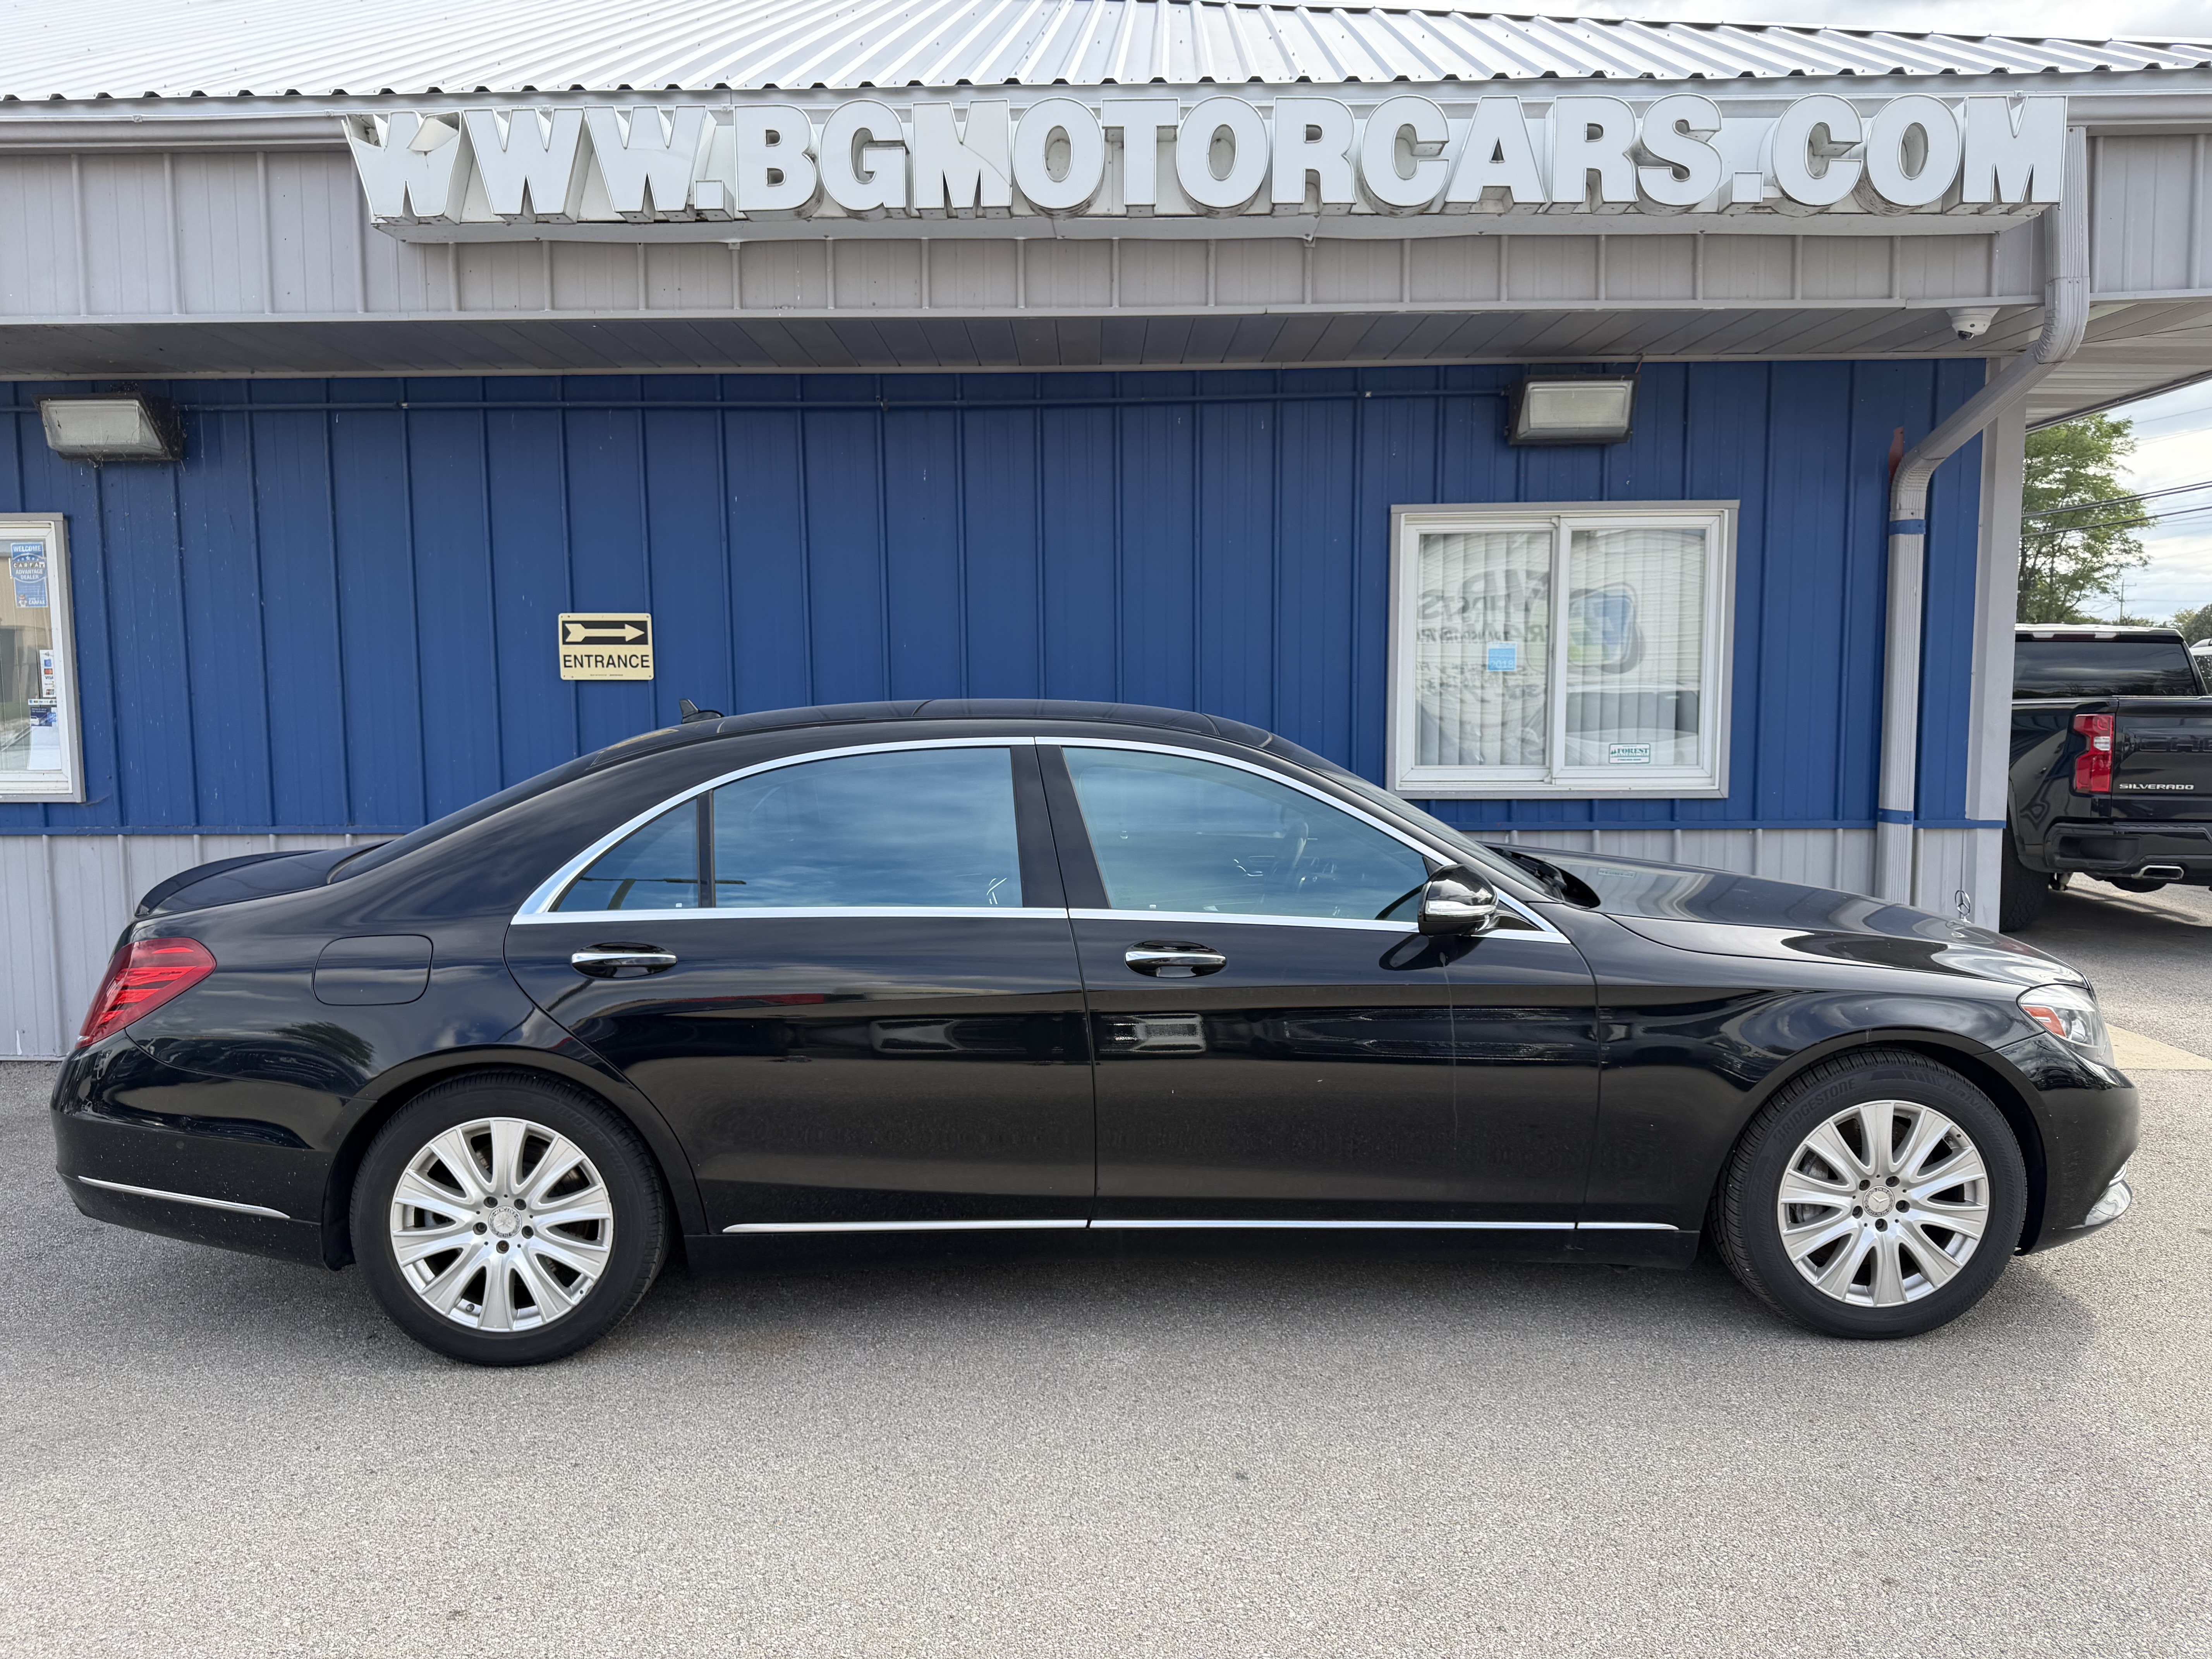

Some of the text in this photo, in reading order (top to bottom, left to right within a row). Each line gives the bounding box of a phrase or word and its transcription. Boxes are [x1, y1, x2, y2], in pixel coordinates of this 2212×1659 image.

[342, 92, 2068, 219] WWW.BGMOTORCARS.COM
[563, 654, 650, 668] ENTRANCE
[1490, 660, 1514, 668] 2018
